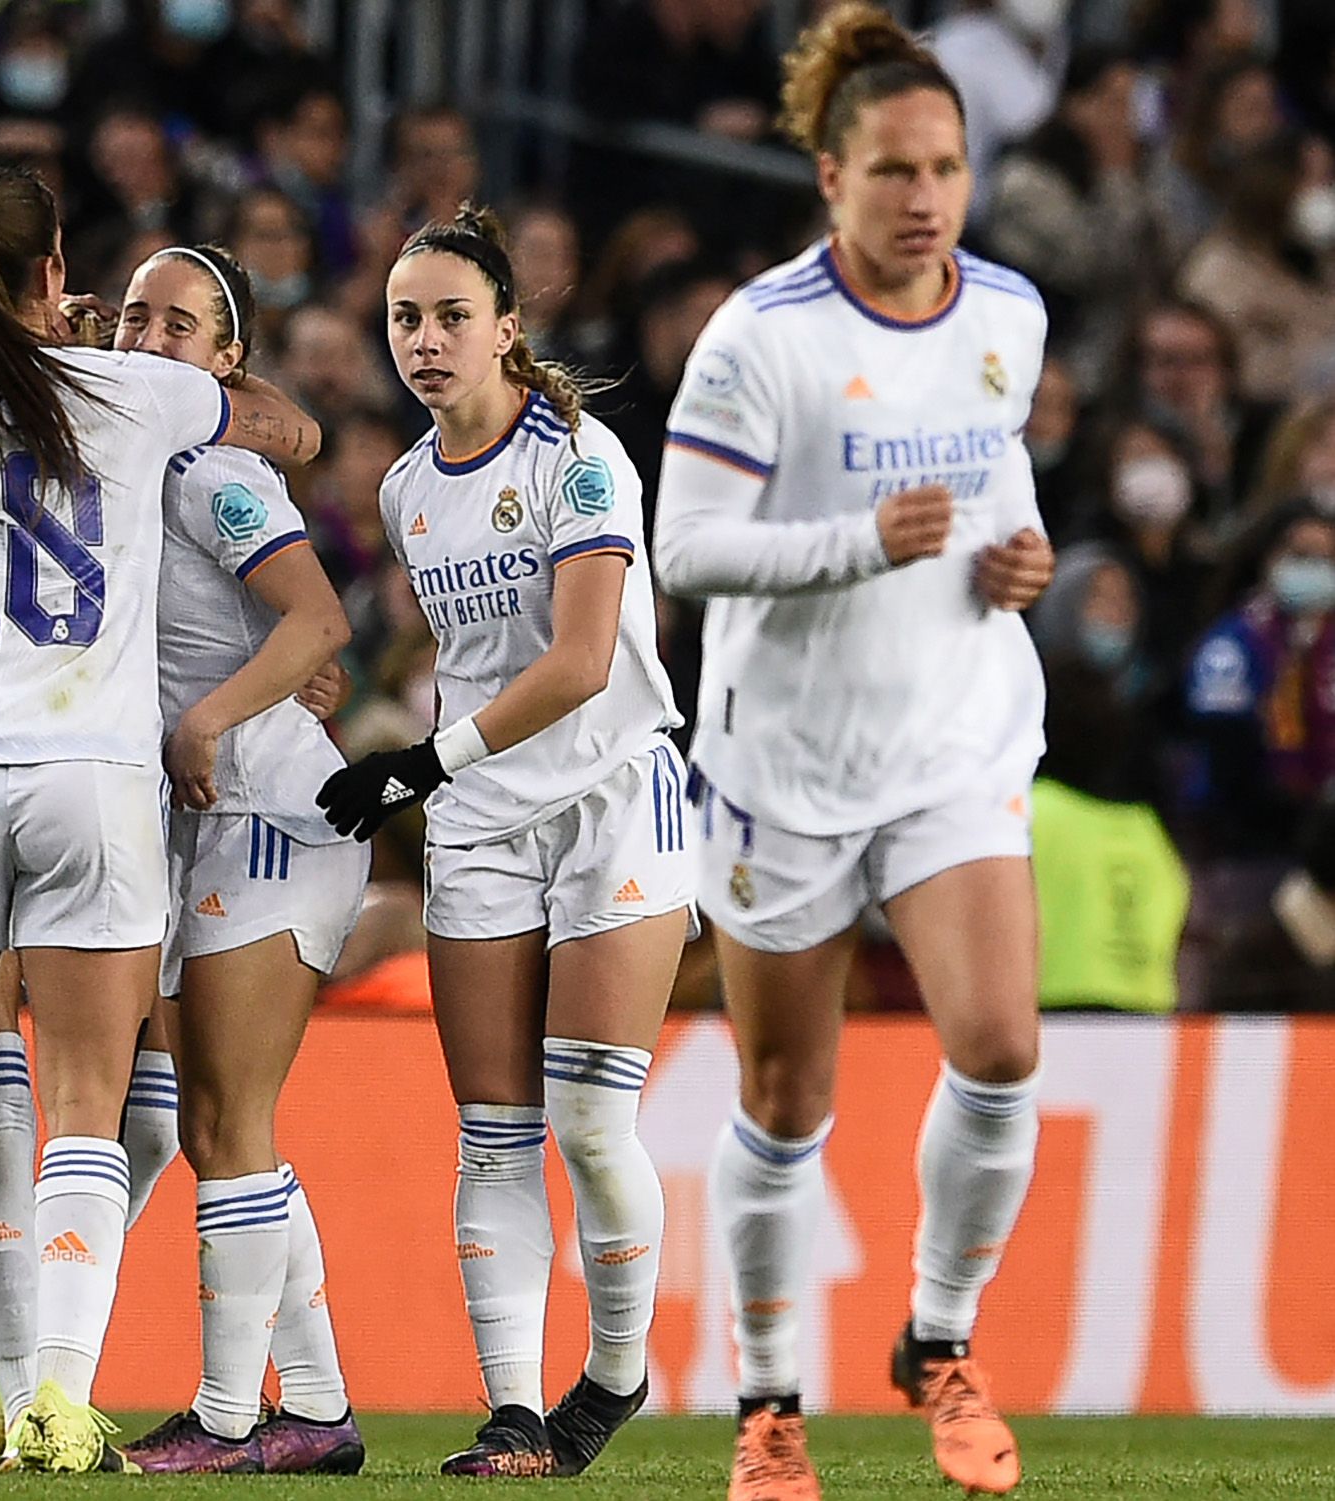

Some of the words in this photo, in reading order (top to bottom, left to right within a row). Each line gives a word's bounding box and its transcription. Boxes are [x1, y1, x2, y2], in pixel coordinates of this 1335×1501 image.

[844, 427, 1006, 472] Emirates
[455, 587, 522, 626] BETTER
[40, 1249, 97, 1266] adidas
